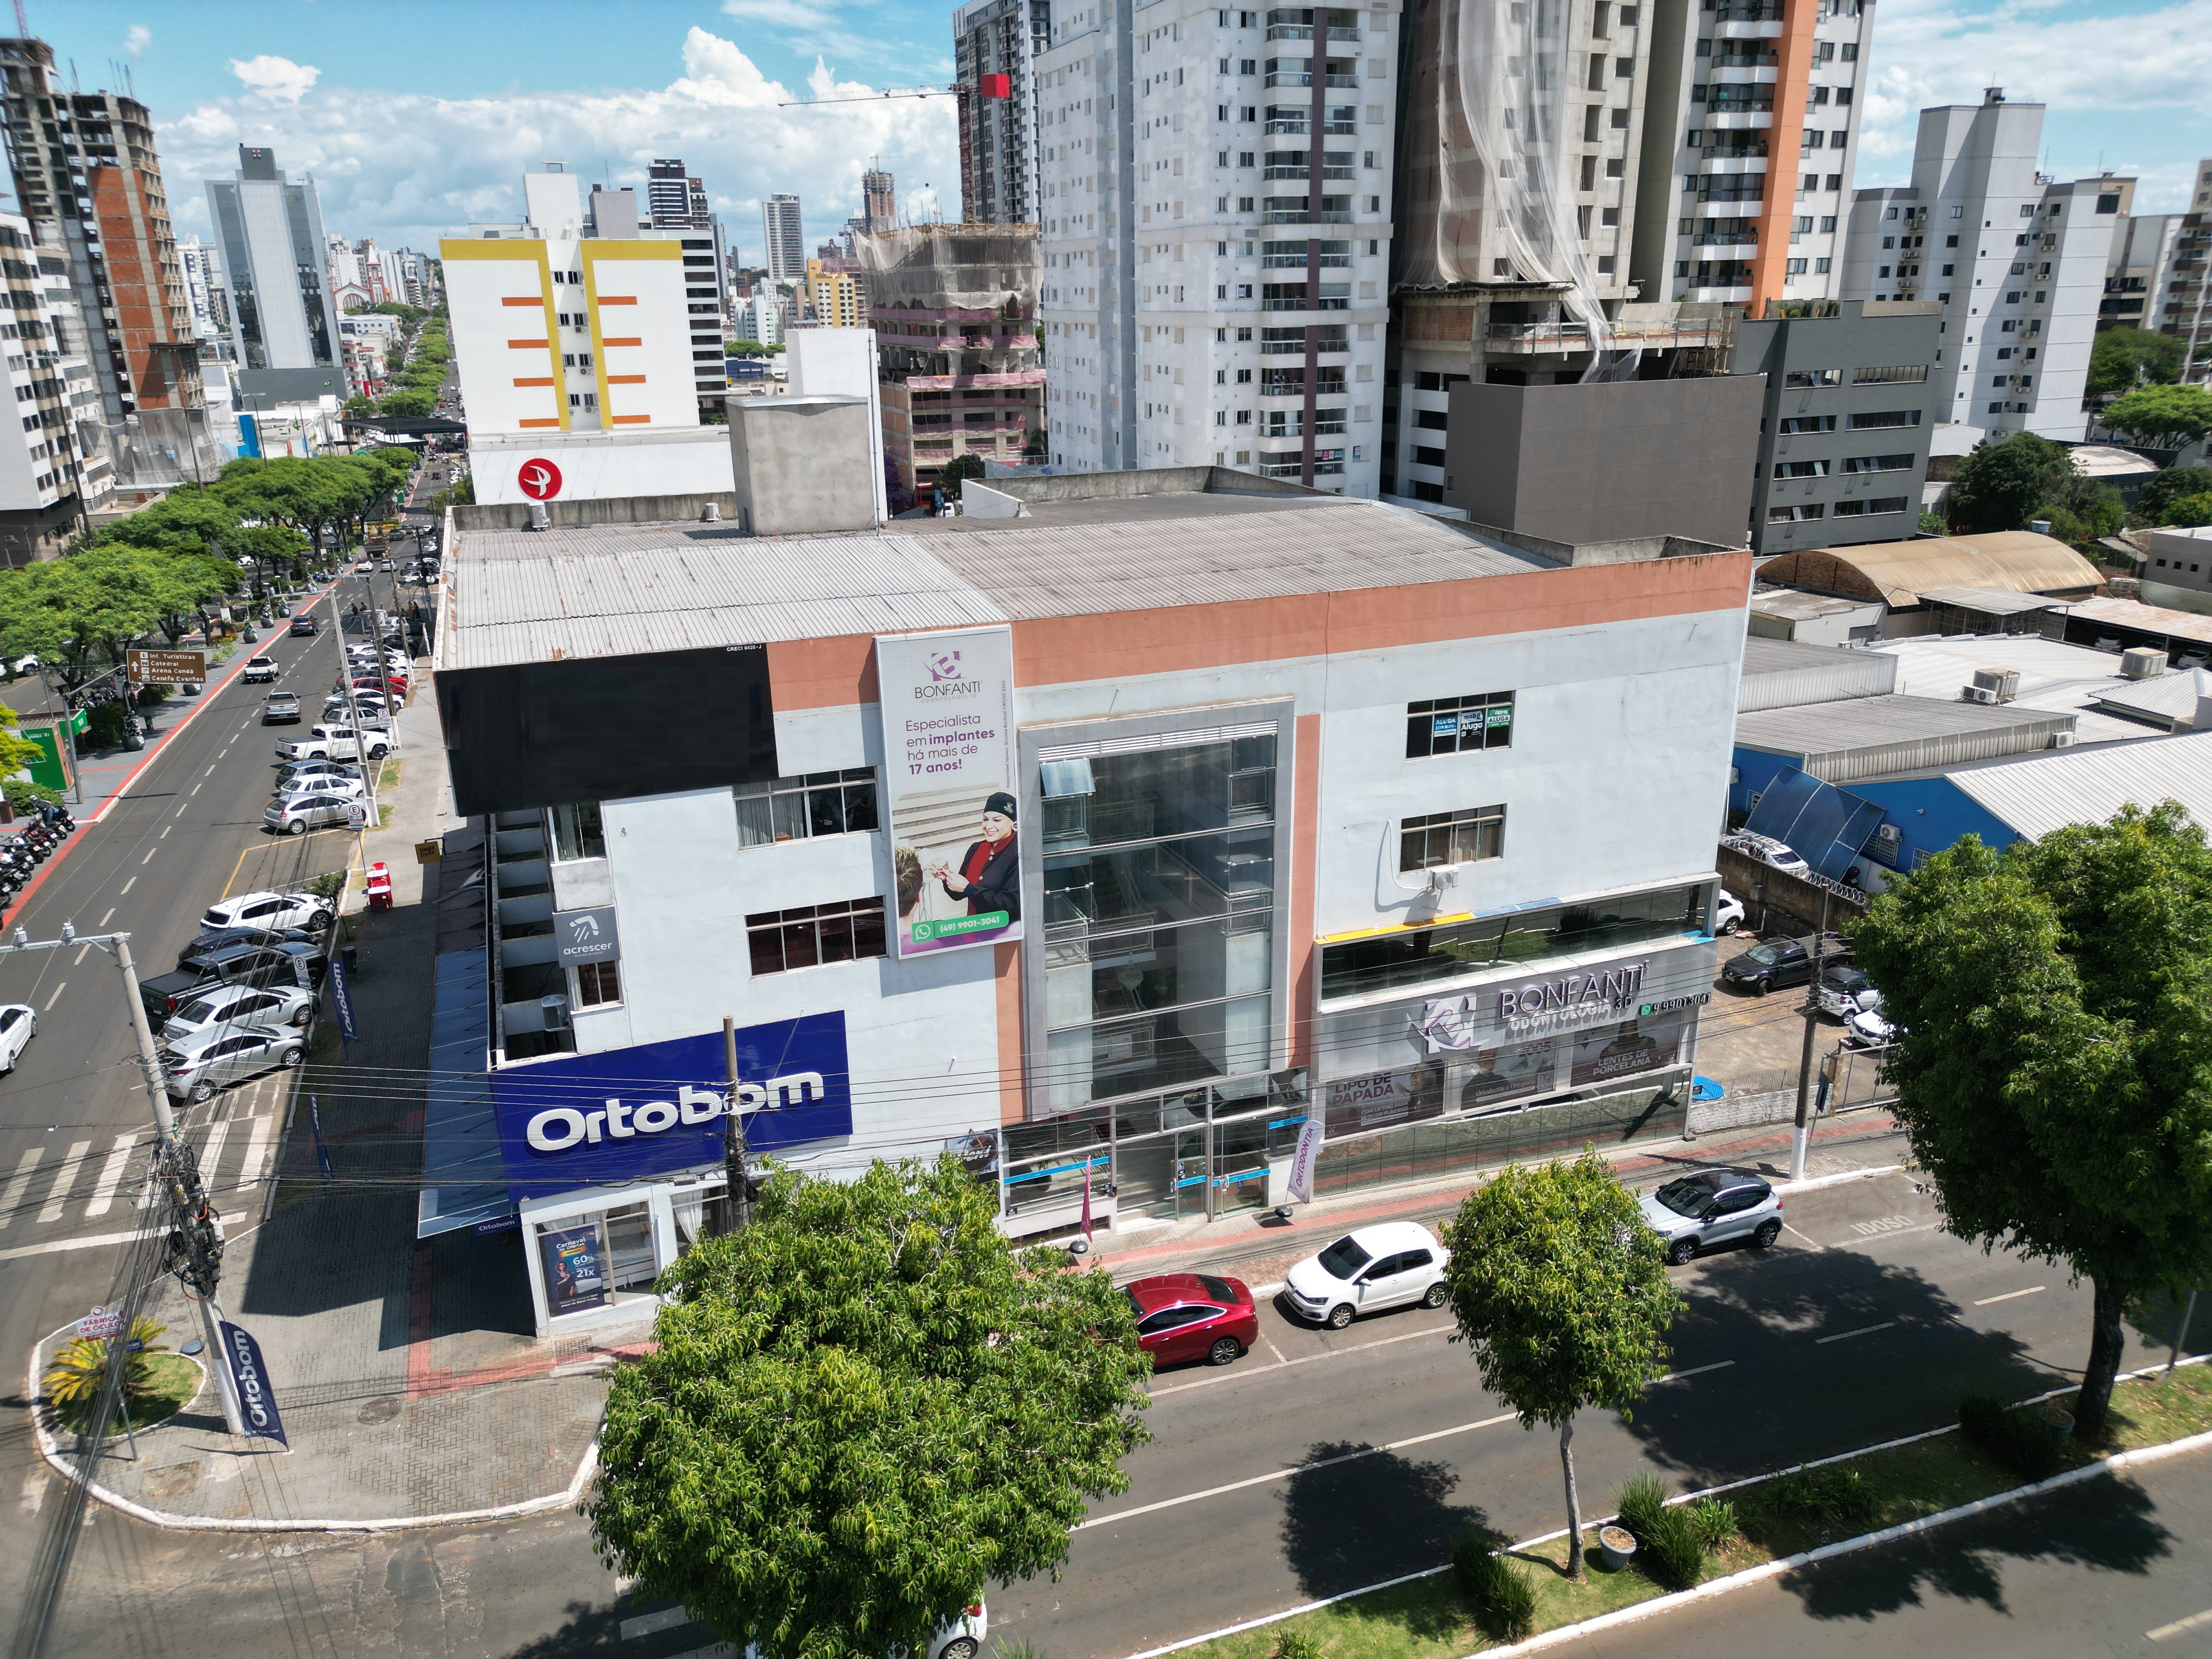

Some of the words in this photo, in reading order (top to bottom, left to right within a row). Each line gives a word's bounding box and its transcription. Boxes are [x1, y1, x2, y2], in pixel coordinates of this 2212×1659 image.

[915, 681, 980, 698] BONFANTI
[921, 695, 968, 703] ODONTOLOGIA
[906, 715, 980, 732] Especialista
[1461, 722, 1483, 731] Aluga
[906, 737, 927, 747] em
[929, 730, 995, 745] implantes
[907, 749, 924, 761] há
[928, 746, 957, 759] mais
[961, 743, 978, 754] de
[909, 763, 922, 775] 17
[926, 758, 962, 773] anos!
[1742, 873, 1747, 882] 6
[940, 923, 956, 933] (49)
[957, 916, 1000, 929] 9901-3041
[563, 943, 612, 955] acrescer
[334, 963, 352, 1032] Ortobom
[1501, 964, 1645, 1019] BONFANTI
[1652, 1001, 1660, 1015] 9
[1661, 992, 1712, 1012] 99013041
[1510, 998, 1611, 1031] ODONTOLOGIA
[1615, 995, 1633, 1011] 3D
[1598, 1052, 1633, 1066] LENTES
[1635, 1048, 1649, 1057] DE
[1593, 1057, 1651, 1076] PORCELANA
[1335, 1077, 1368, 1093] LIPO
[1373, 1071, 1391, 1086] DE
[1333, 1084, 1394, 1105] PAPADA
[1476, 1086, 1505, 1096] Ortodontia
[527, 1072, 823, 1151] Ortobom
[1375, 1104, 1393, 1112] LIFTING
[1296, 1127, 1313, 1187] ORTODONTIA
[479, 1221, 515, 1231] Ortobom
[1849, 1215, 1914, 1235] IDOSO
[556, 1237, 585, 1249] Carnaval
[573, 1255, 595, 1265] 60%
[576, 1269, 595, 1278] 21x
[233, 1330, 267, 1426] Ortobom
